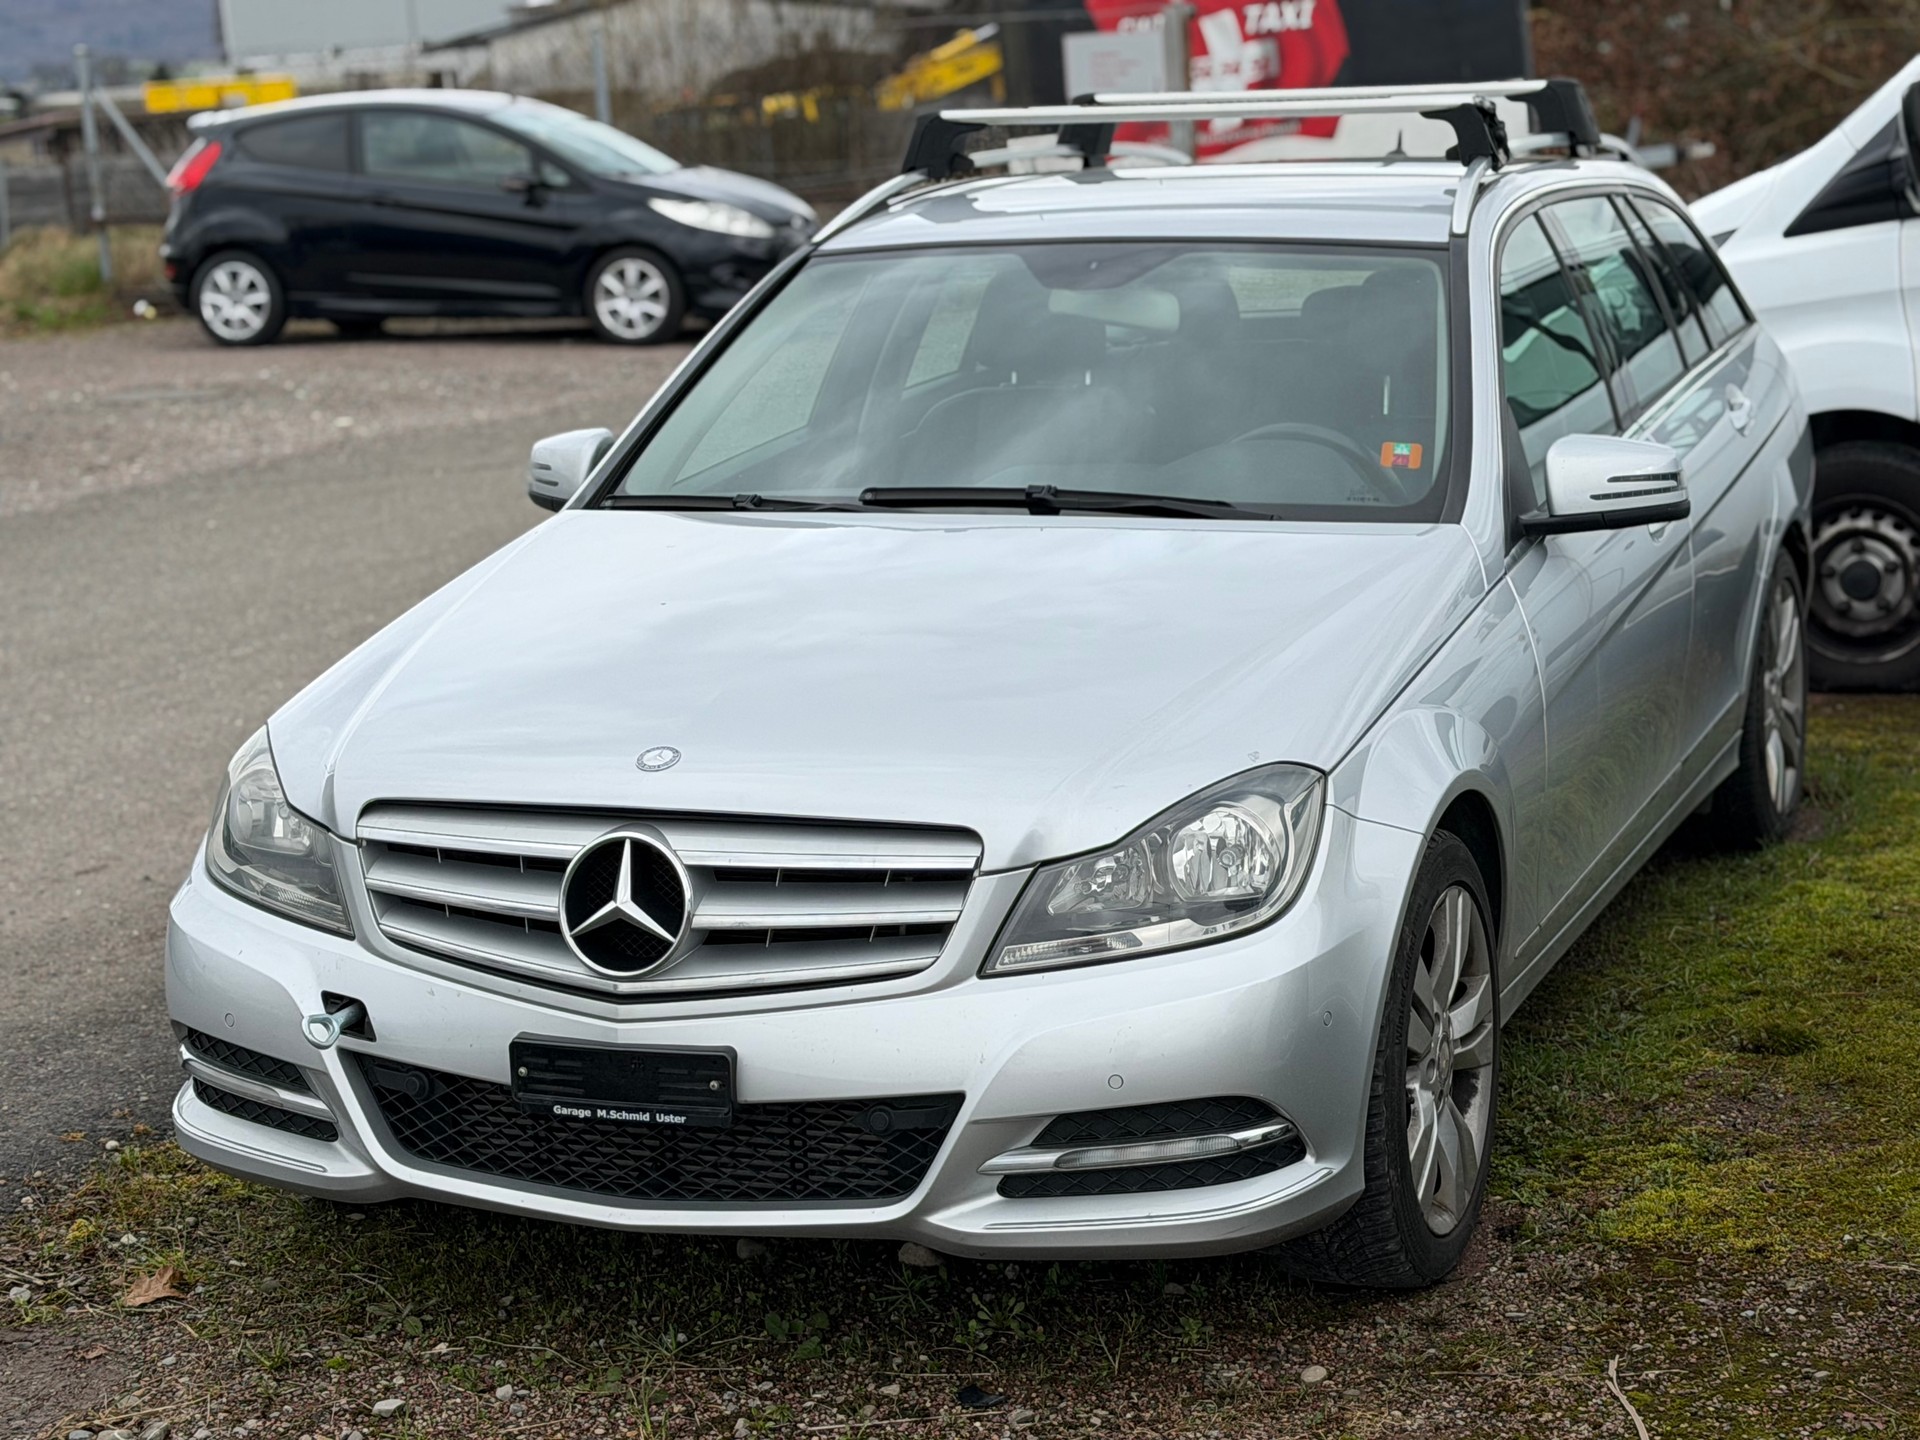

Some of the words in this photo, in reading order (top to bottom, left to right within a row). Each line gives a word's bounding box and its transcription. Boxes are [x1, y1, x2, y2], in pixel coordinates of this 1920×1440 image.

[1243, 0, 1316, 35] TAXI
[1395, 930, 1417, 1046] WinterContact
[553, 1105, 592, 1118] Garage
[597, 1109, 650, 1122] M.Schmid
[656, 1113, 687, 1123] Uster
